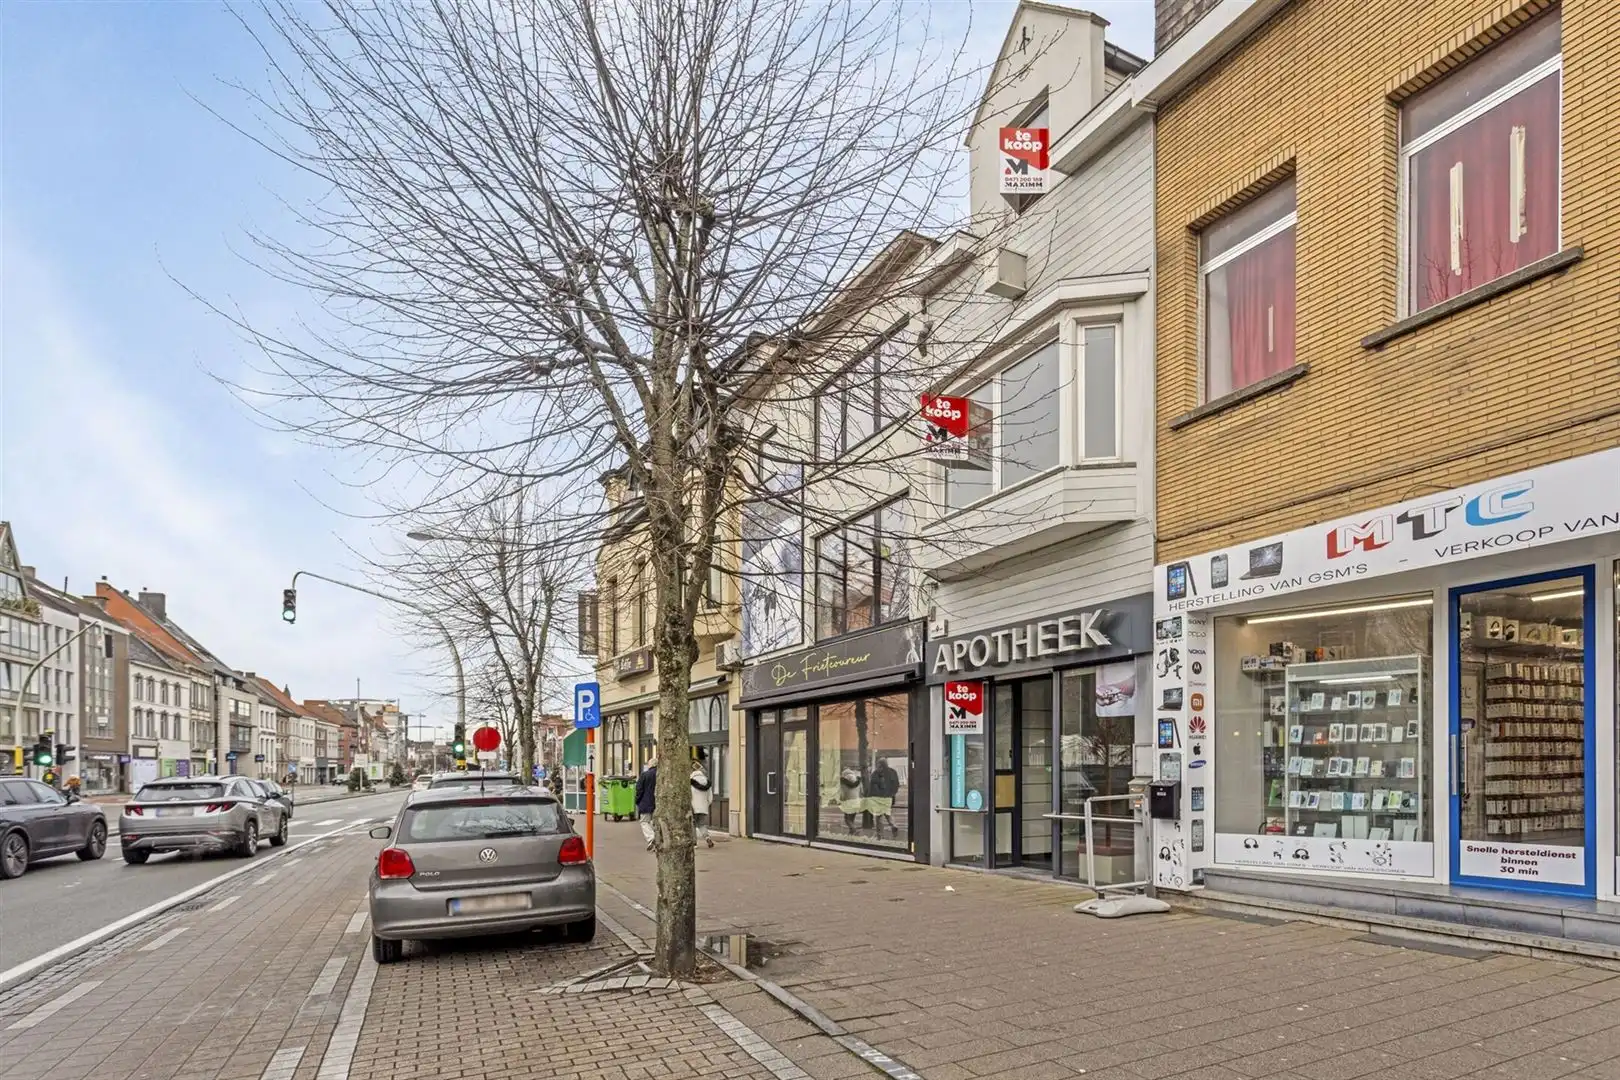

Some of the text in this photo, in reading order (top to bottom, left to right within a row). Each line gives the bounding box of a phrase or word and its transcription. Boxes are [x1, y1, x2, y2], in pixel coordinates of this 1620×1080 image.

[1015, 130, 1032, 141] te
[1004, 138, 1043, 153] koop
[936, 398, 951, 409] te
[925, 405, 961, 421] koop
[1326, 479, 1535, 559] MTC
[1168, 584, 1265, 612] HERSTELLING
[1270, 576, 1302, 592] VAN
[1308, 563, 1368, 584] GSM'S
[1434, 526, 1554, 558] VERKOOP
[1564, 512, 1620, 533] VAN
[933, 608, 1112, 674] APOTHEEK
[771, 652, 871, 687] De Frietcoureur
[957, 684, 969, 692] te
[948, 691, 977, 701] koop
[577, 690, 595, 722] P
[1466, 845, 1577, 859] Snelle hersteldienst
[1500, 857, 1538, 866] binnen
[1500, 866, 1539, 876] 30 min
